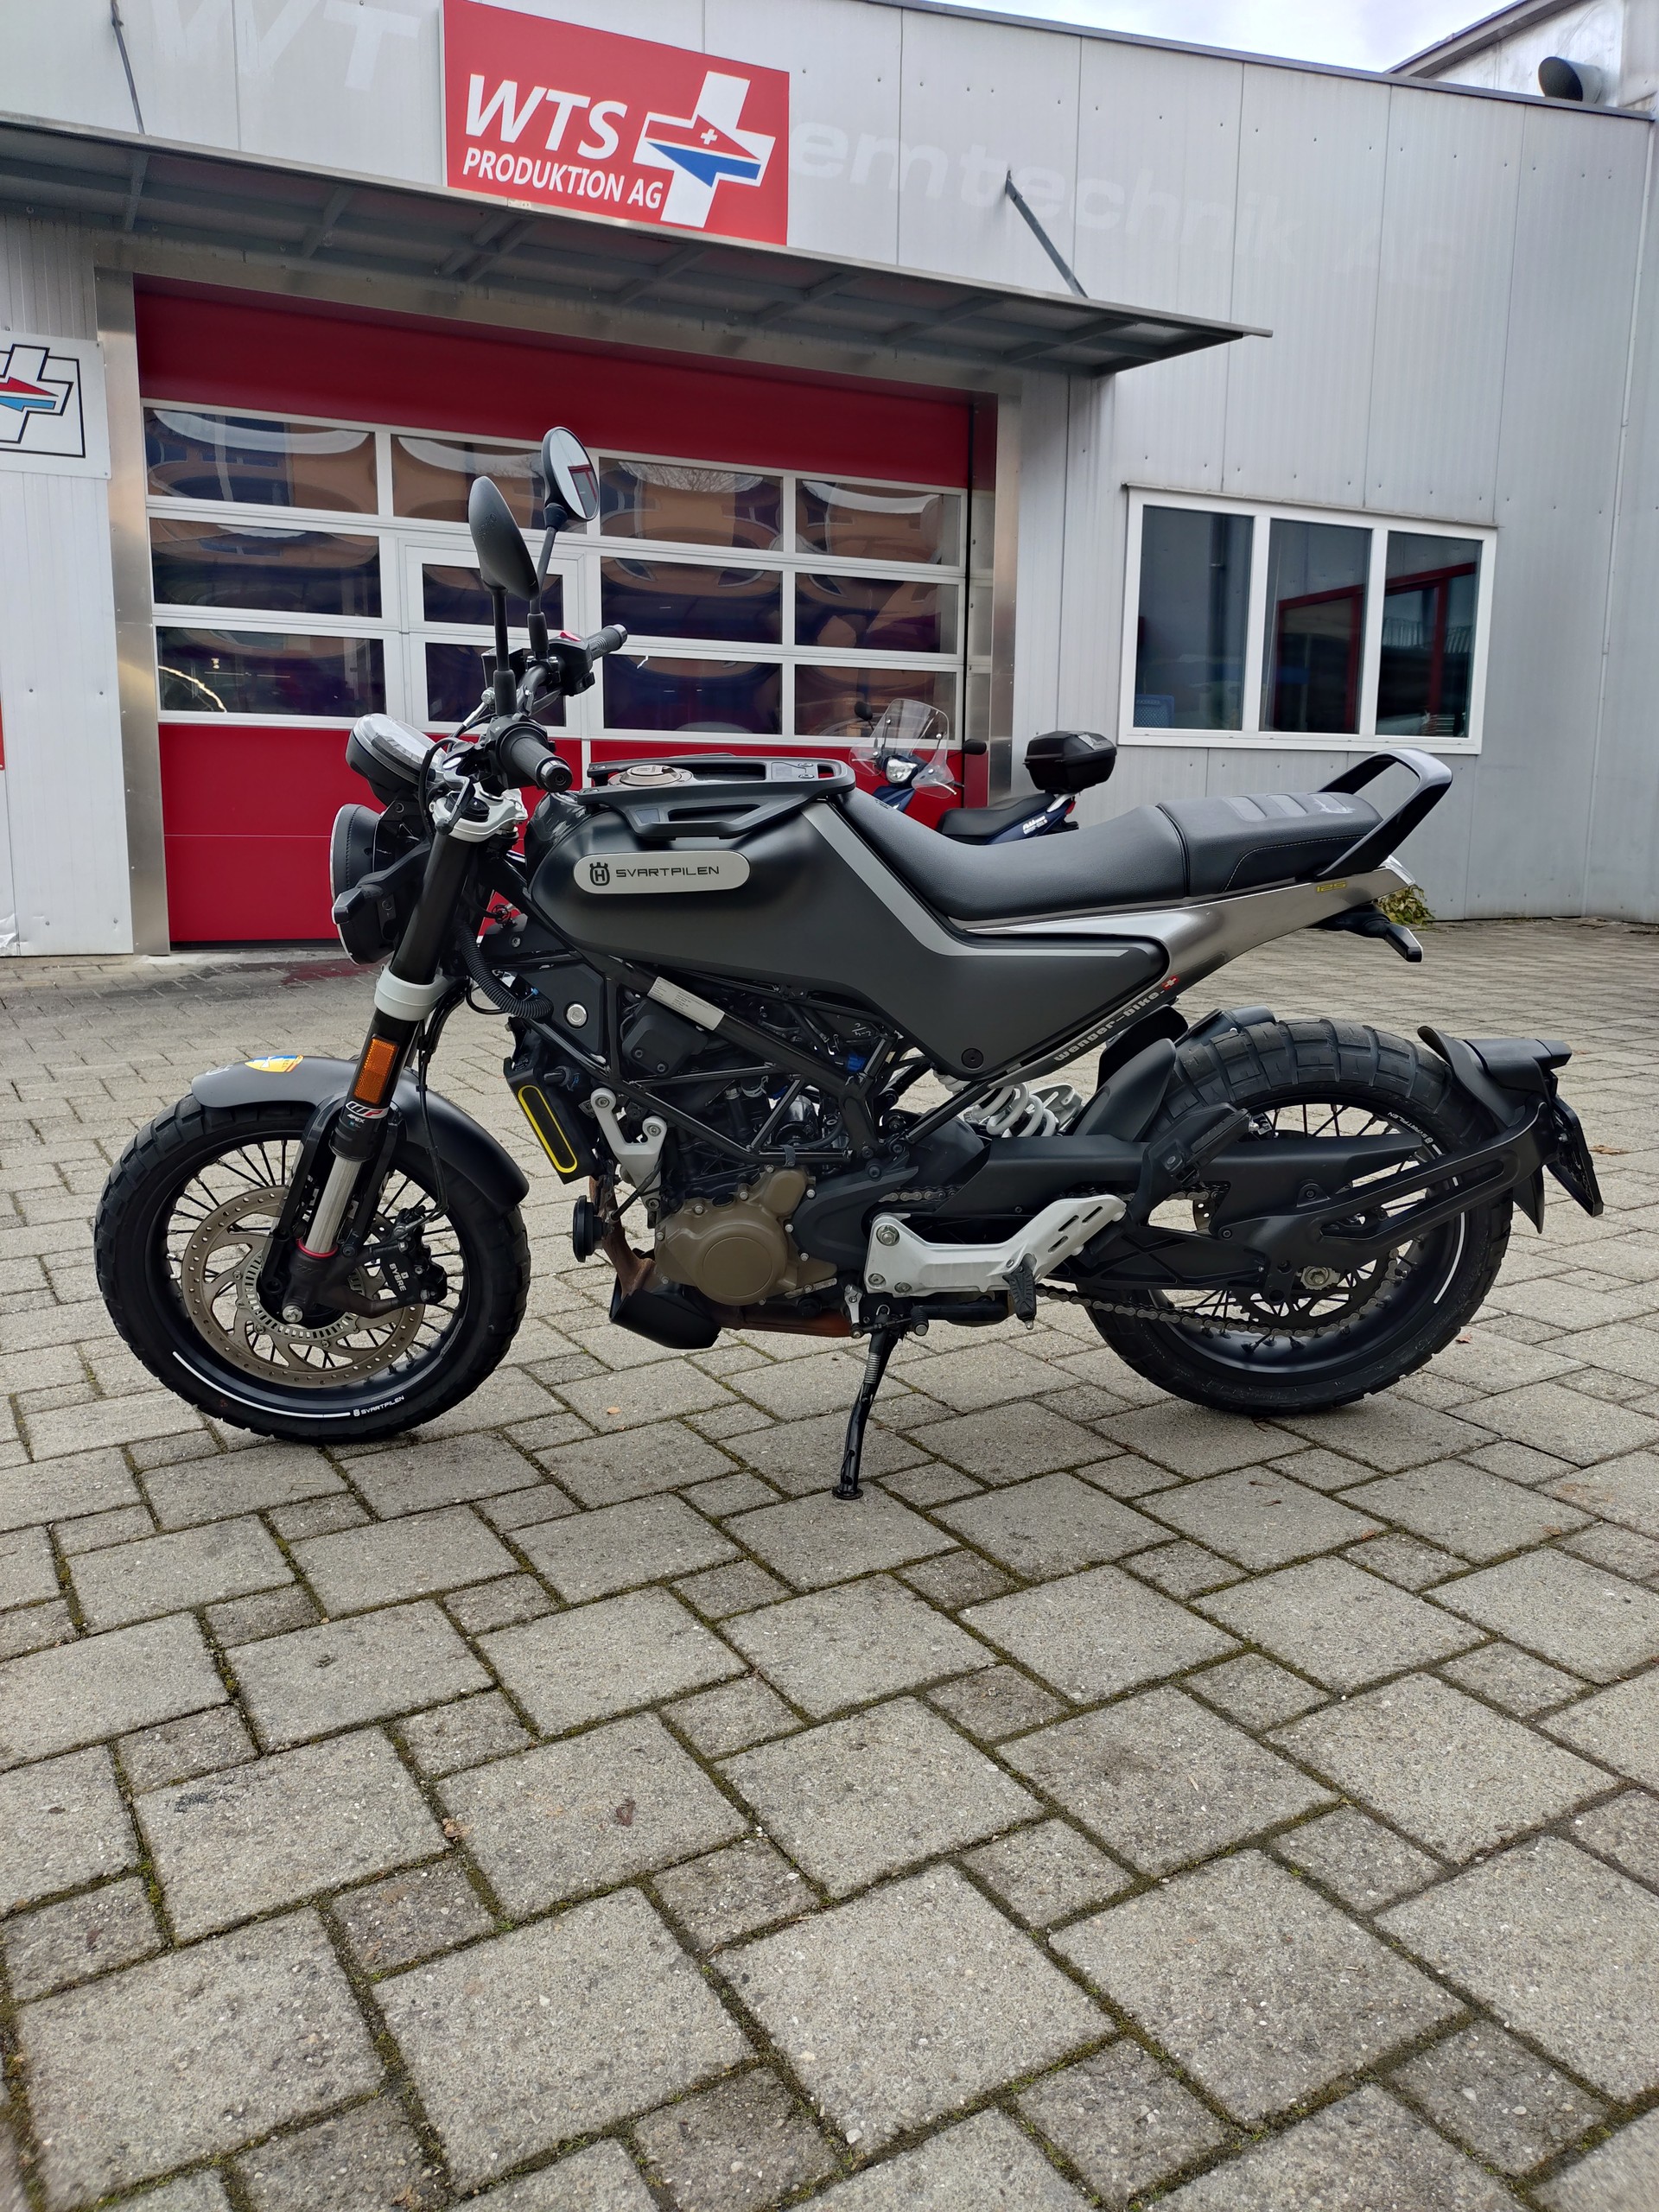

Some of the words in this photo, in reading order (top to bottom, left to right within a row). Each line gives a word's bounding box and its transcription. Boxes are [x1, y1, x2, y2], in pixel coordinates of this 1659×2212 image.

[465, 73, 628, 160] WTS
[462, 147, 625, 202] PRODUKTION
[626, 178, 664, 209] AG
[615, 866, 720, 878] SVARTPILEN
[1316, 881, 1346, 893] 125
[346, 1113, 365, 1124] APEX
[1387, 1111, 1428, 1139] SVARTPILEN
[389, 1262, 407, 1292] BYBRE
[360, 1395, 404, 1414] SVARTPILEN
